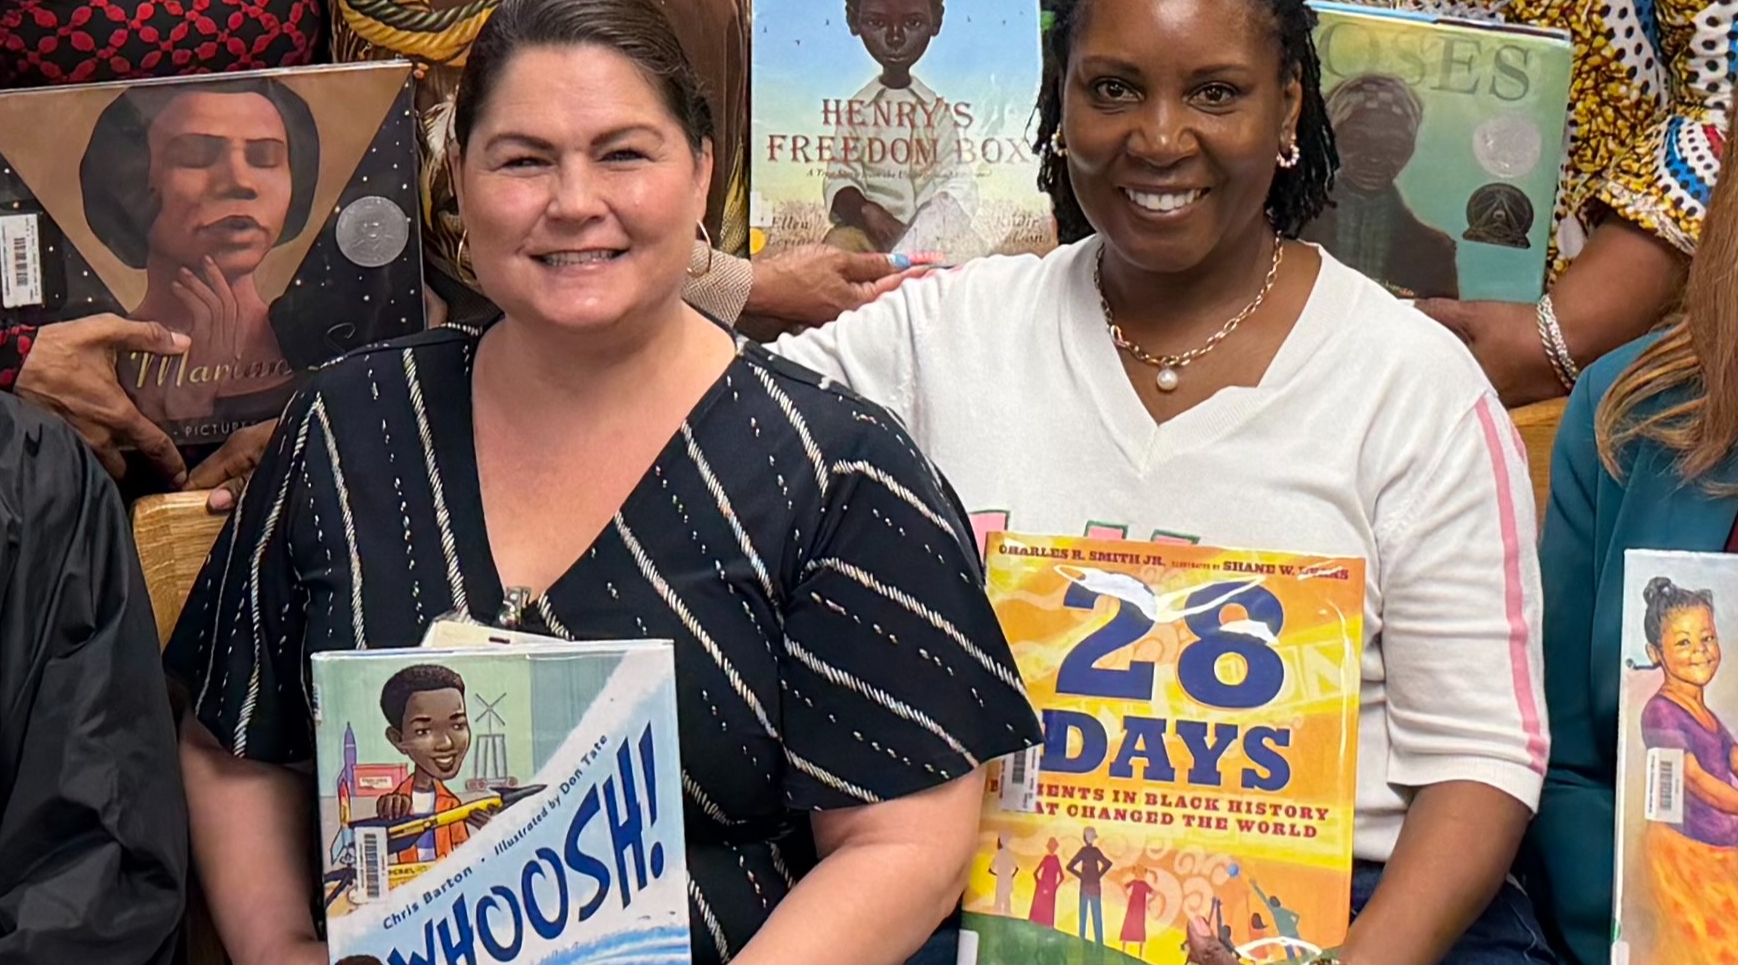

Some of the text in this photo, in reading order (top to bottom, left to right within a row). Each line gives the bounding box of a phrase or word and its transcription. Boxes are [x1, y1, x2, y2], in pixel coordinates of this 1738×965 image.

[820, 98, 976, 129] HENRY'S
[766, 134, 1030, 166] FREEDOM BOX
[998, 543, 1296, 576] CHARLES R. SMITH JR. SHANE W.
[1054, 570, 1286, 709] 28
[1039, 708, 1292, 793] DAYS
[493, 732, 609, 856] Illustrated by Don Tate
[1113, 789, 1330, 822] IN BLACK HISTORY
[387, 720, 665, 965] WHOOSH!
[1065, 804, 1319, 840] CHANGED THE WORLD
[382, 865, 474, 931] Chris Barton
